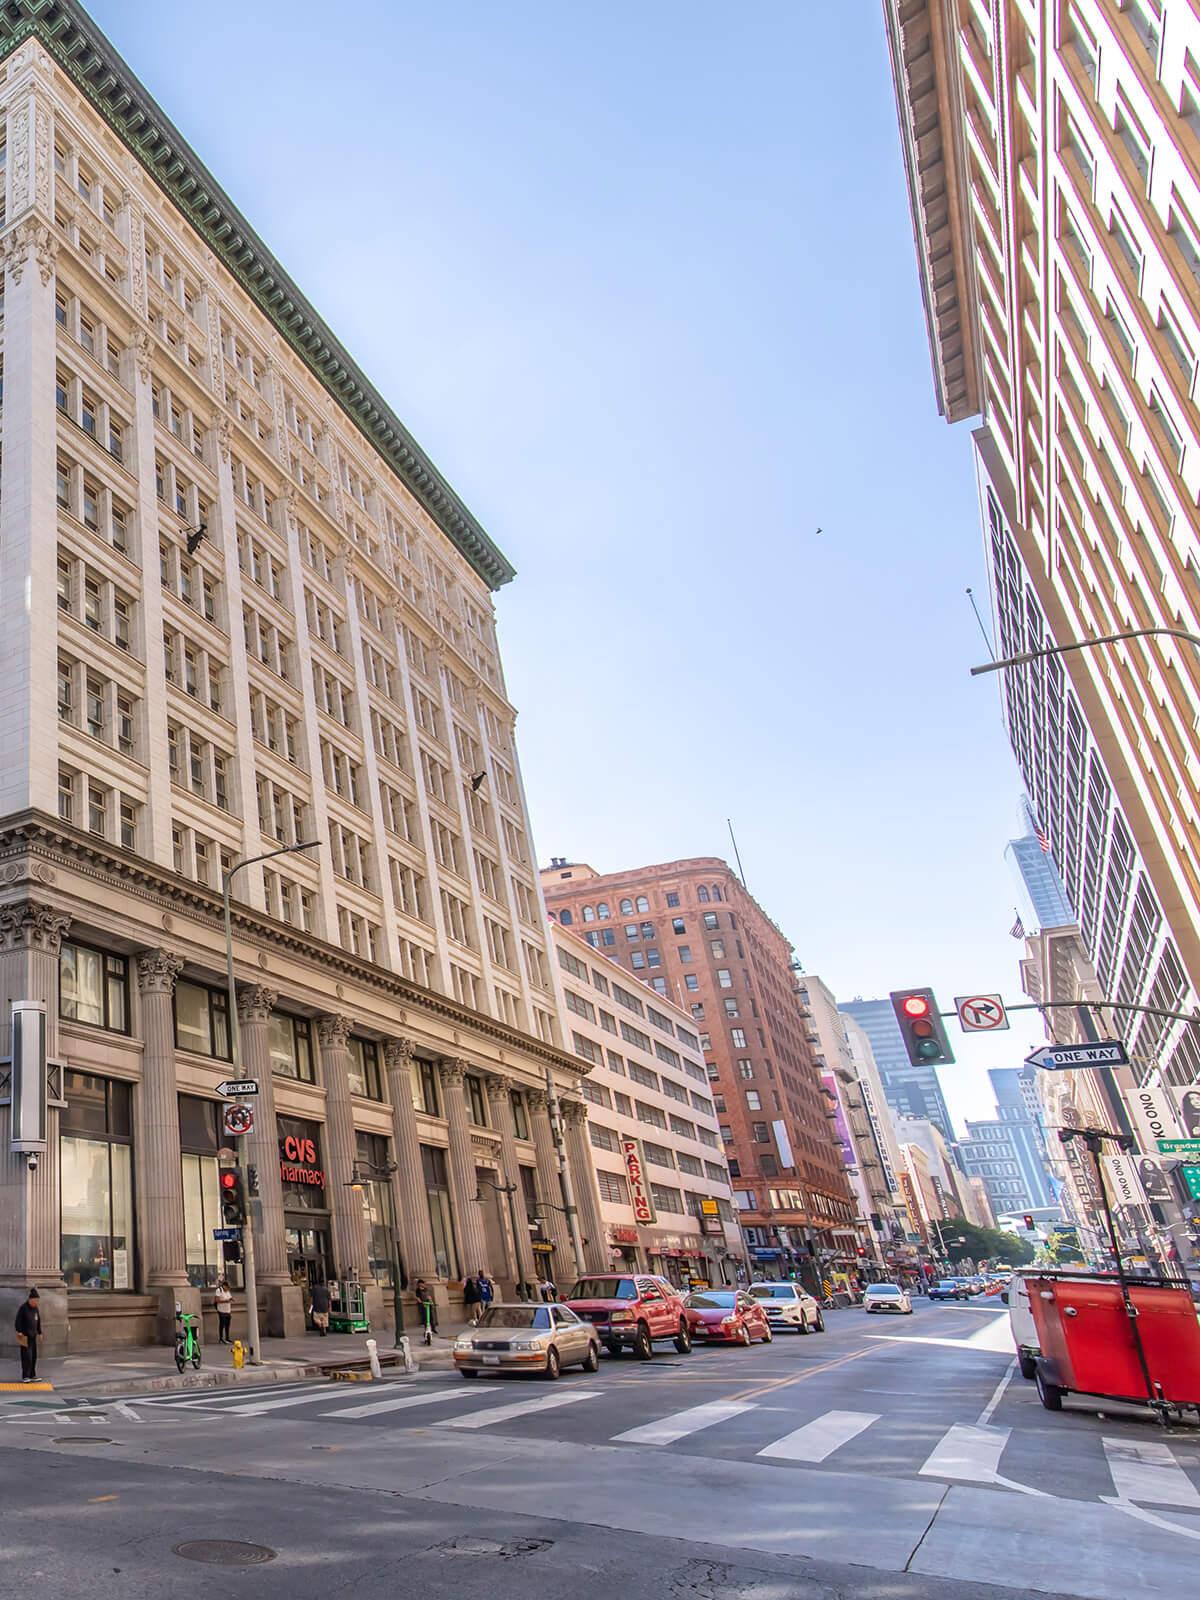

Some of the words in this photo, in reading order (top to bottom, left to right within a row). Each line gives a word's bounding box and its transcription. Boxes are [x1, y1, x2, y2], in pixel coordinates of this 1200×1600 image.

[1054, 1051, 1083, 1063] ONE
[1086, 1048, 1115, 1061] WAY
[241, 1083, 255, 1091] WAY
[1139, 1093, 1159, 1119] ONO
[284, 1135, 317, 1164] CVS
[1112, 1159, 1125, 1176] ONO
[624, 1142, 650, 1219] PARKING
[1118, 1177, 1133, 1200] YOKO
